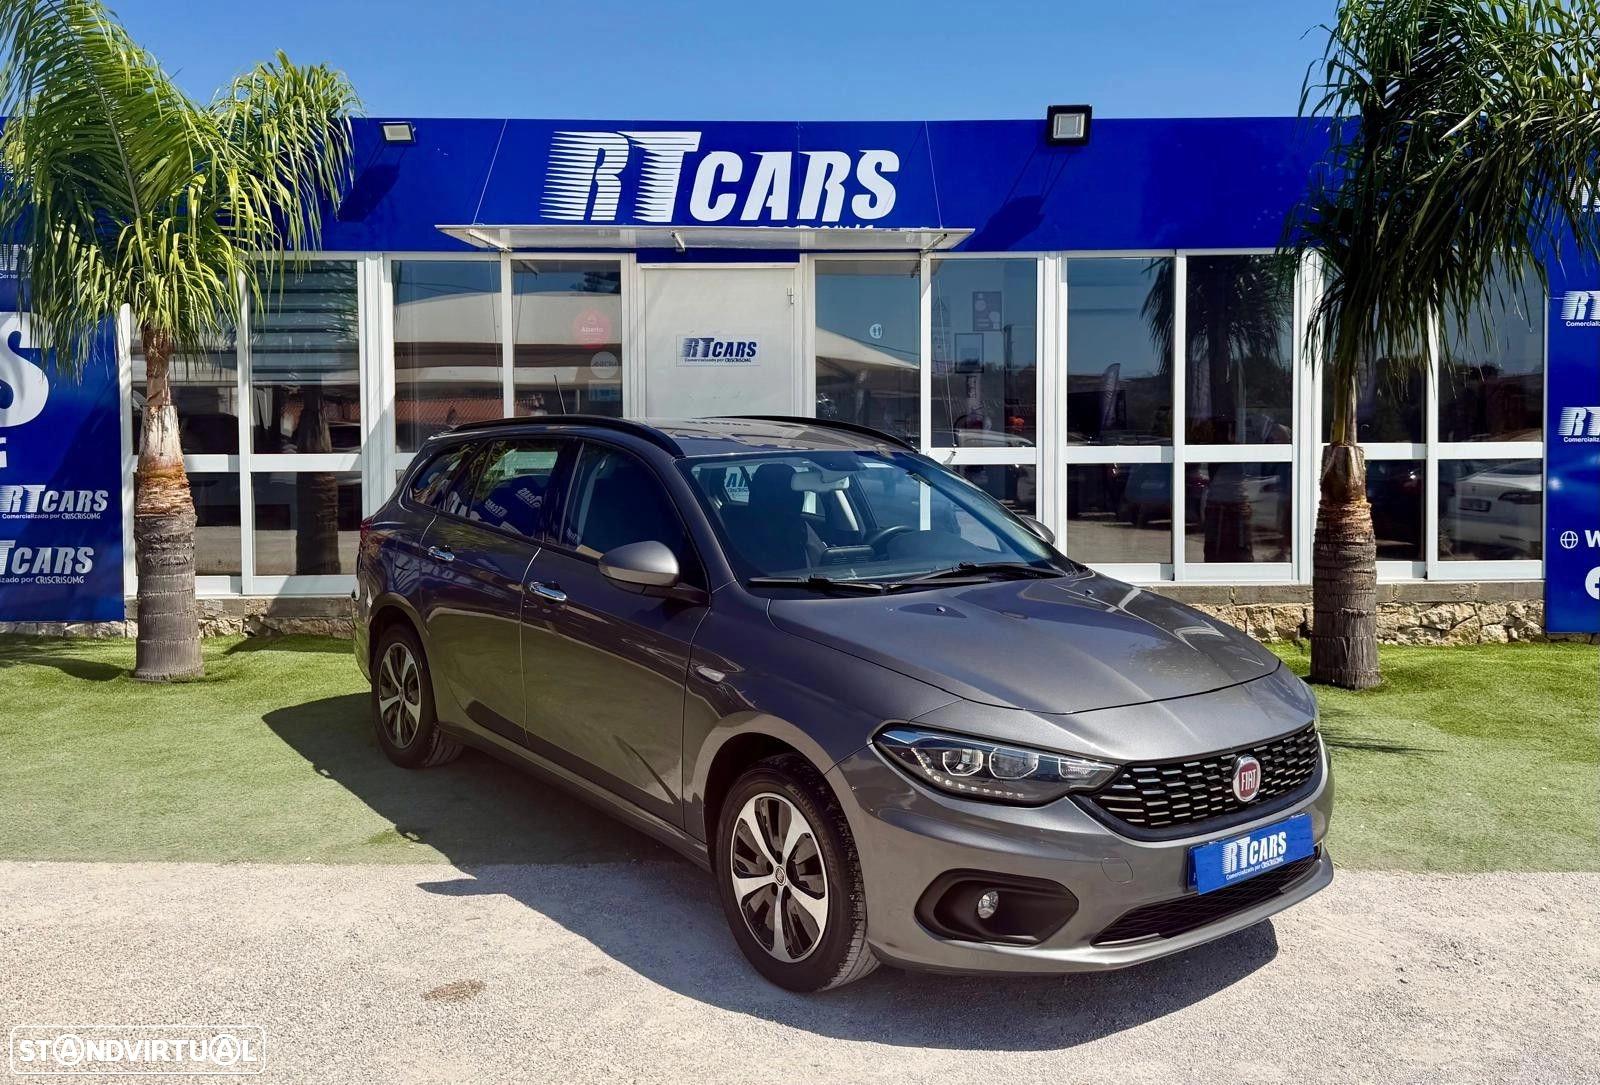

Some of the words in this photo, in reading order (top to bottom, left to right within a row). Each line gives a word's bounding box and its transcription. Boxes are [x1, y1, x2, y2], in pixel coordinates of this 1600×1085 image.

[540, 131, 900, 222] RTCARS
[682, 337, 758, 358] RTCARS
[0, 484, 109, 513] RTCARS
[49, 513, 60, 521] por
[1241, 769, 1257, 791] FIAT
[1221, 831, 1287, 874] RTCARS
